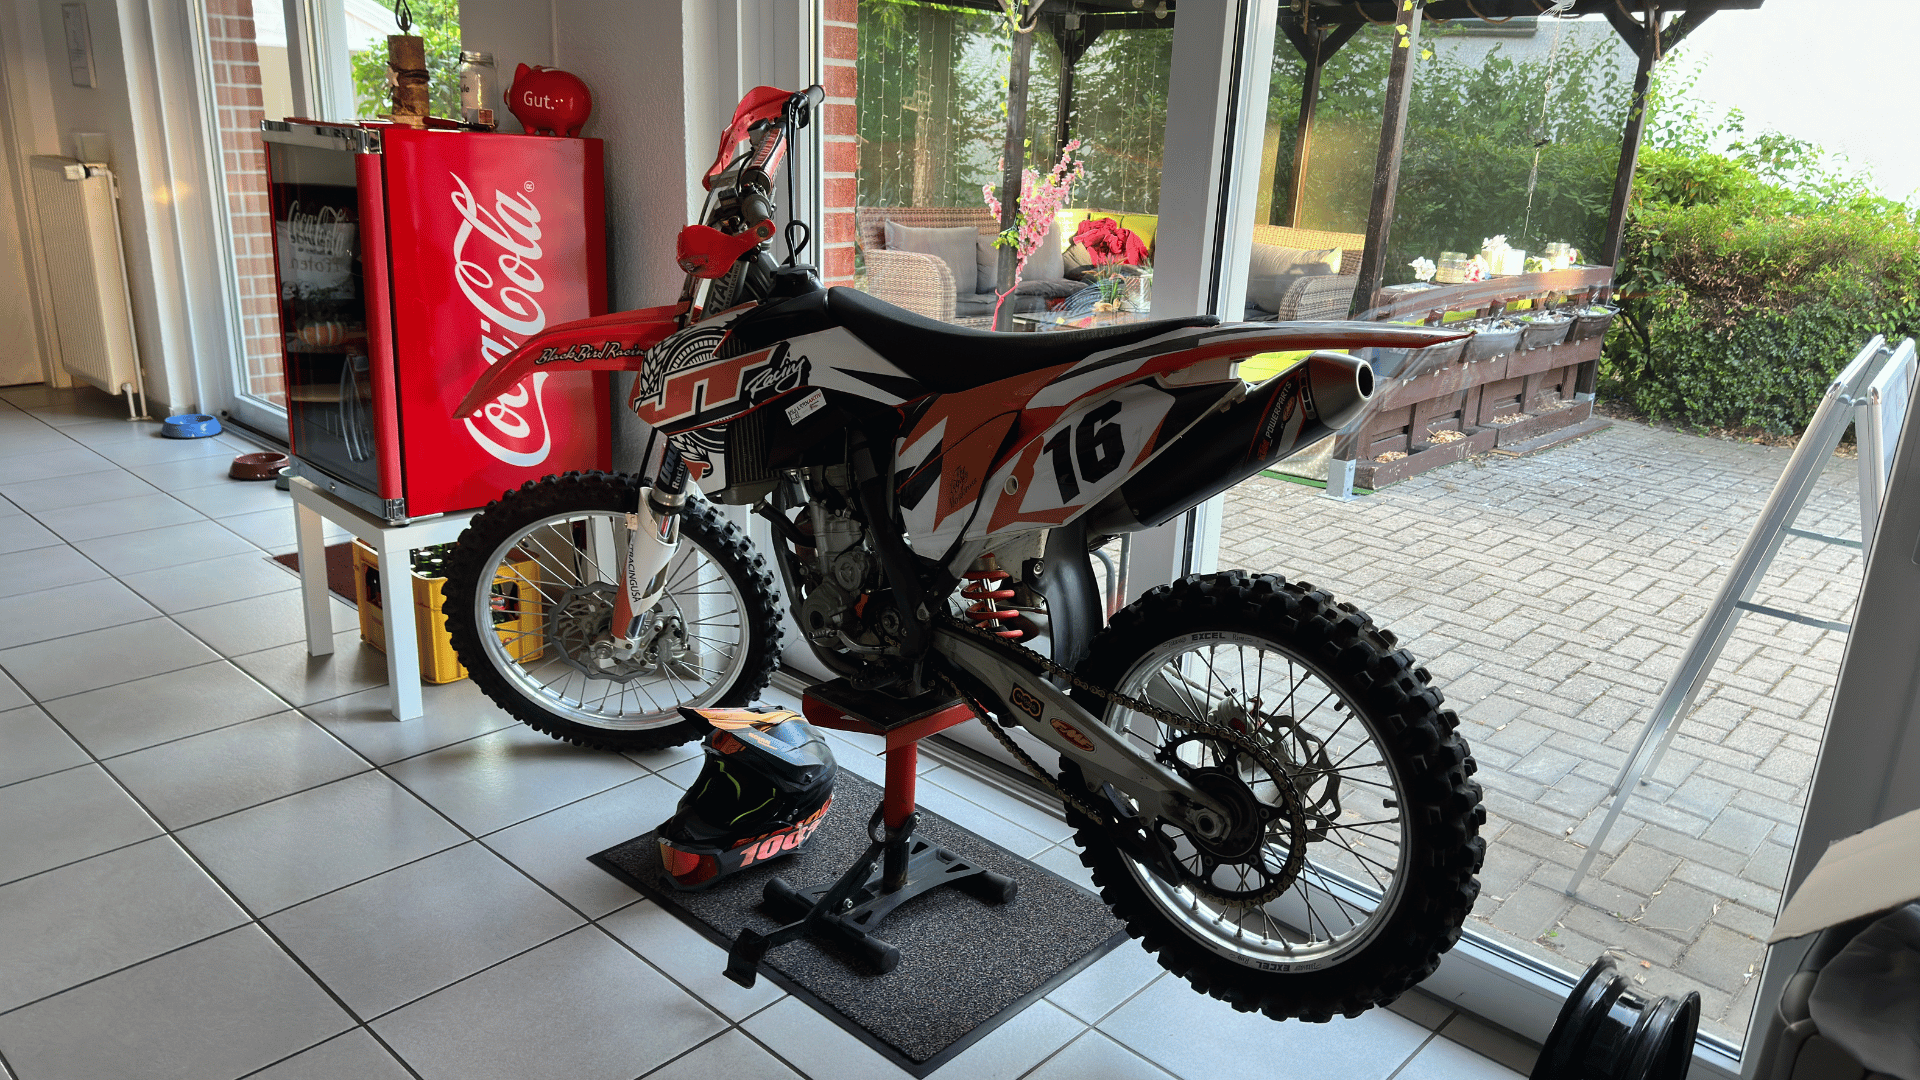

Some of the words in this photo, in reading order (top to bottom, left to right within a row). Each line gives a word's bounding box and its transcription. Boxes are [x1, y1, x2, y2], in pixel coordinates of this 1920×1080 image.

[523, 91, 555, 110] Gut.
[744, 351, 806, 400] Racing
[1265, 381, 1293, 439] POWERPARTS
[1042, 400, 1126, 505] 16
[671, 460, 686, 490] Racin
[1191, 632, 1227, 641] EXCEL
[1255, 960, 1291, 973] EXCEL
